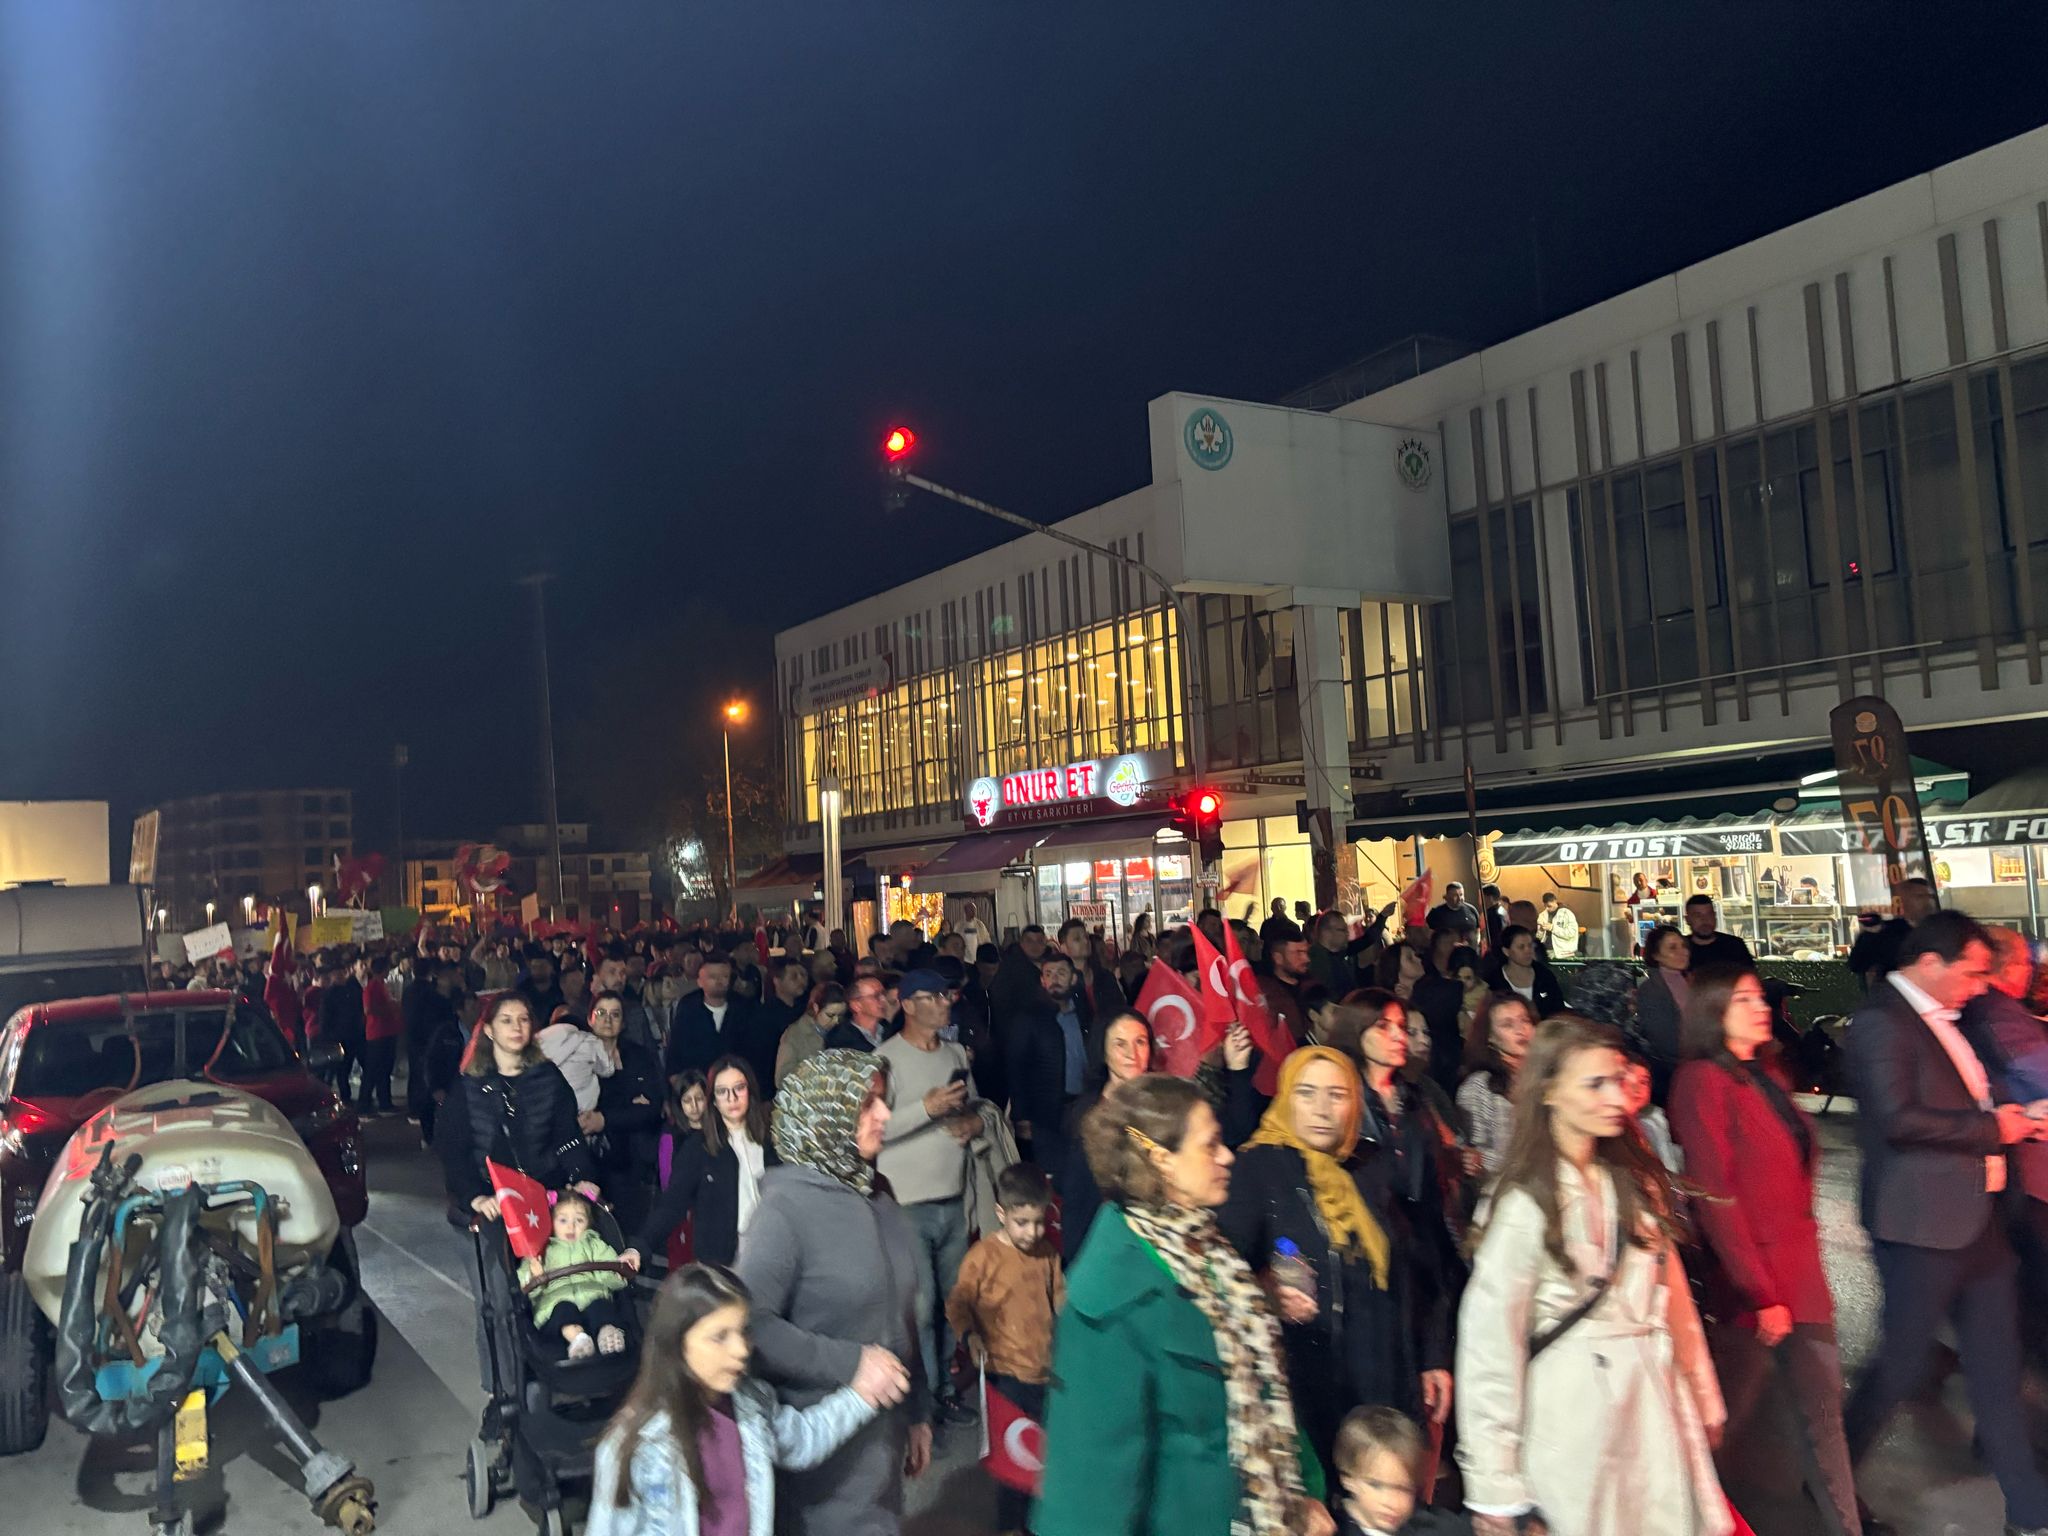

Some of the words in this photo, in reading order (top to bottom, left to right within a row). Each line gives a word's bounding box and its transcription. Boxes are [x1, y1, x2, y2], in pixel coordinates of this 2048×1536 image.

[1004, 771, 1059, 806] ONUR
[1065, 765, 1094, 797] ET
[1008, 812, 1018, 822] ET
[1022, 810, 1033, 820] VE
[1036, 802, 1093, 819] ŞARKÜTERİ
[1560, 842, 1596, 861] 07
[1607, 836, 1687, 859] TOST
[1720, 832, 1763, 844] SARIGÖL
